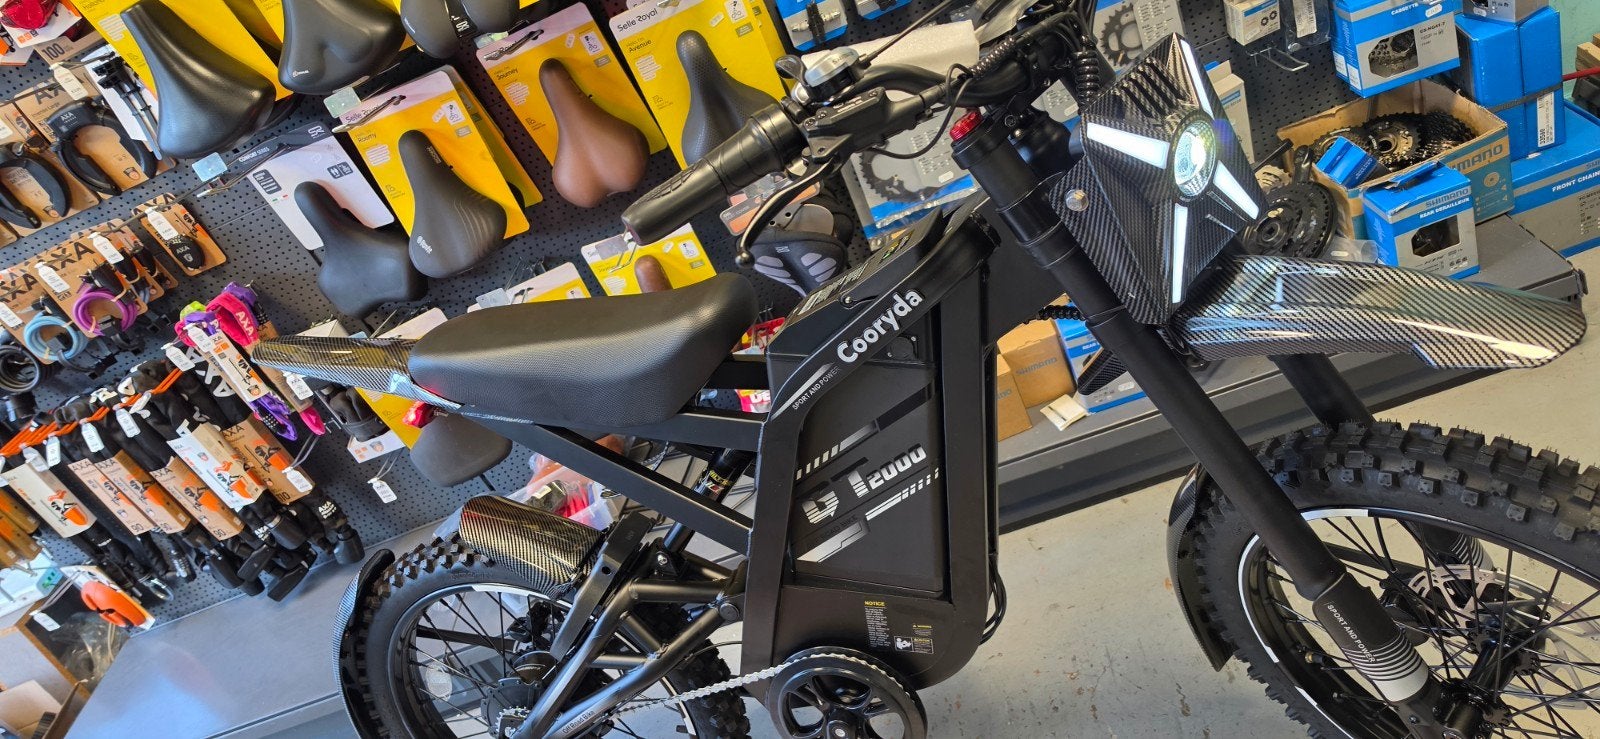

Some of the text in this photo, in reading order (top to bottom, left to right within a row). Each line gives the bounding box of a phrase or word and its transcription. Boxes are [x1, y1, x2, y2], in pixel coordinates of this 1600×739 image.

[617, 8, 660, 32] Selle Royal
[42, 43, 65, 60] 100
[628, 39, 652, 53] Avenue
[496, 67, 519, 81] Journey
[60, 112, 75, 122] AXA
[1552, 179, 1576, 192] FRONT
[1425, 188, 1469, 207] SHIMANO
[1420, 197, 1470, 219] REAR DERAILLEUR
[236, 311, 255, 336] AXA
[836, 288, 924, 363] Cooryda
[1015, 357, 1058, 375] SHIMANO
[792, 365, 841, 410] SPORT AND POWER
[318, 501, 332, 513] AXA
[1327, 604, 1376, 663] SPORT AND POWER
